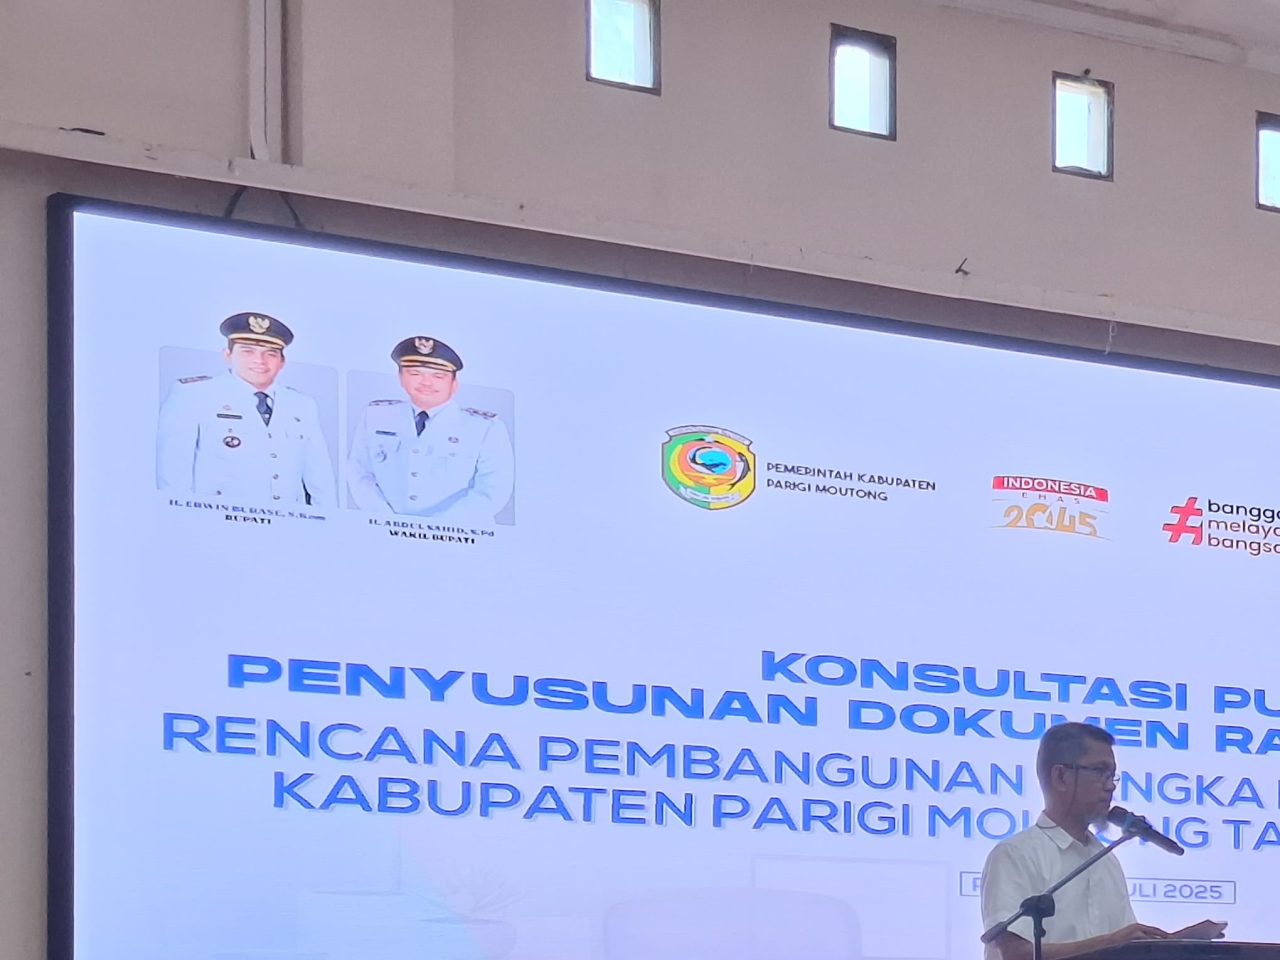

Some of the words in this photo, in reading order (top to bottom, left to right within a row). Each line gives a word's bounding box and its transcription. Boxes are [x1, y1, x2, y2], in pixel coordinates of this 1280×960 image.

[766, 478, 811, 493] PARIGI
[815, 484, 888, 501] MOUTONG
[857, 473, 936, 491] KABUPATEN
[1003, 477, 1097, 498] INDONESIA
[1003, 503, 1097, 536] 2045
[228, 654, 818, 727] PENYUSUNAN
[761, 650, 1187, 711] KONSULTASI
[163, 712, 521, 770] RENCANA
[538, 735, 1023, 796] PEMBANGUNAN
[1121, 770, 1264, 809] NGKA
[273, 771, 694, 827] KABUPATEN
[713, 794, 910, 836] PARIGI
[1163, 884, 1222, 899] 2025
